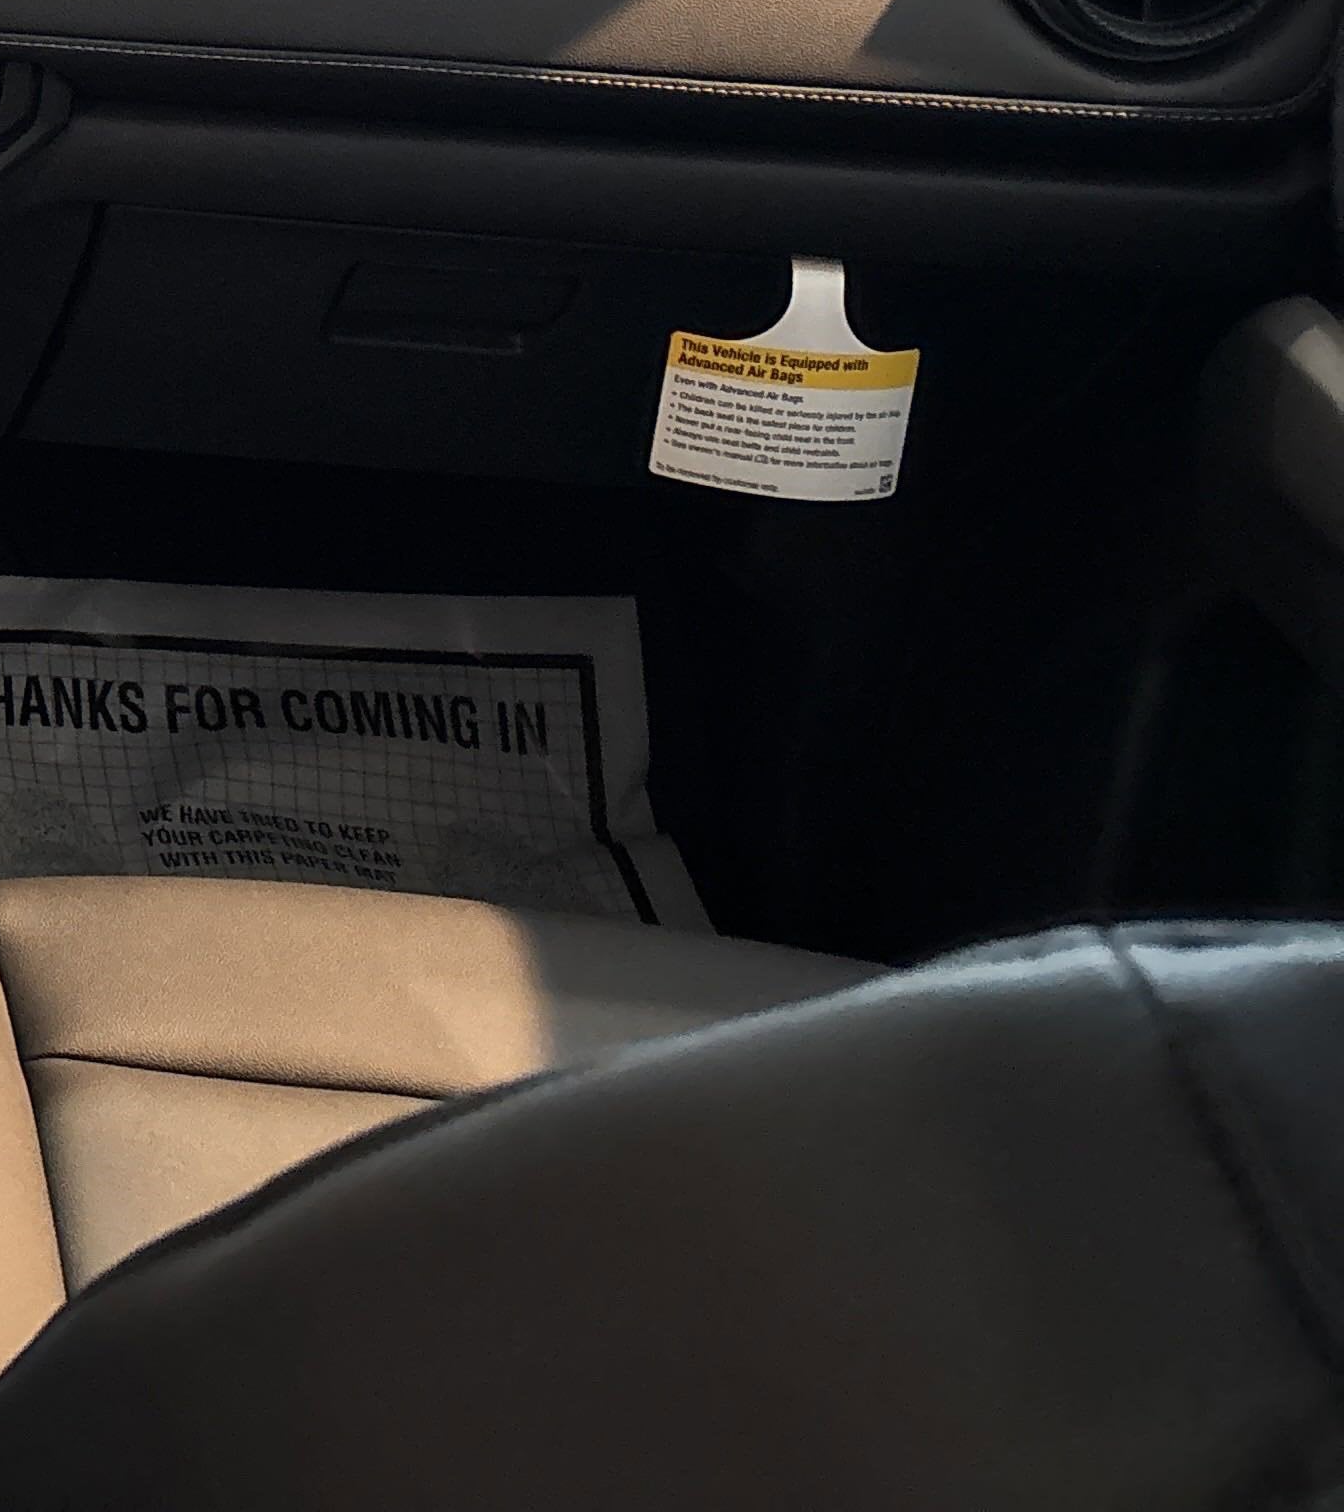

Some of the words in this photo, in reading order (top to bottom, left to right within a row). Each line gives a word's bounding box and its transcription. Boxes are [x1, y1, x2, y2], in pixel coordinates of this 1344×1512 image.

[678, 352, 743, 376] Advanced
[748, 364, 767, 379] Air
[770, 368, 804, 385] Bags
[681, 338, 709, 356] This
[713, 344, 760, 364] Vehicle
[765, 349, 777, 365] is
[781, 354, 840, 372] Equipped
[844, 359, 869, 372] with
[674, 374, 696, 386] Even
[698, 380, 717, 390] with
[720, 383, 765, 398] Advanced
[766, 391, 779, 400] Air
[782, 392, 804, 404] Bags
[164, 683, 268, 734] FOR
[281, 687, 479, 750] COMING
[498, 699, 551, 756] IN
[139, 803, 172, 825] WE
[179, 805, 234, 826] HAVE
[240, 810, 301, 833] TRIED
[303, 819, 333, 839] TO
[338, 824, 391, 844] KEEP
[140, 827, 204, 848] YOUR
[207, 829, 328, 855] CARPETING
[334, 844, 402, 869] CLEAN
[160, 850, 218, 869] WITH
[223, 849, 275, 867] THIS
[281, 853, 350, 875] PAPER
[353, 864, 398, 885] MAT
